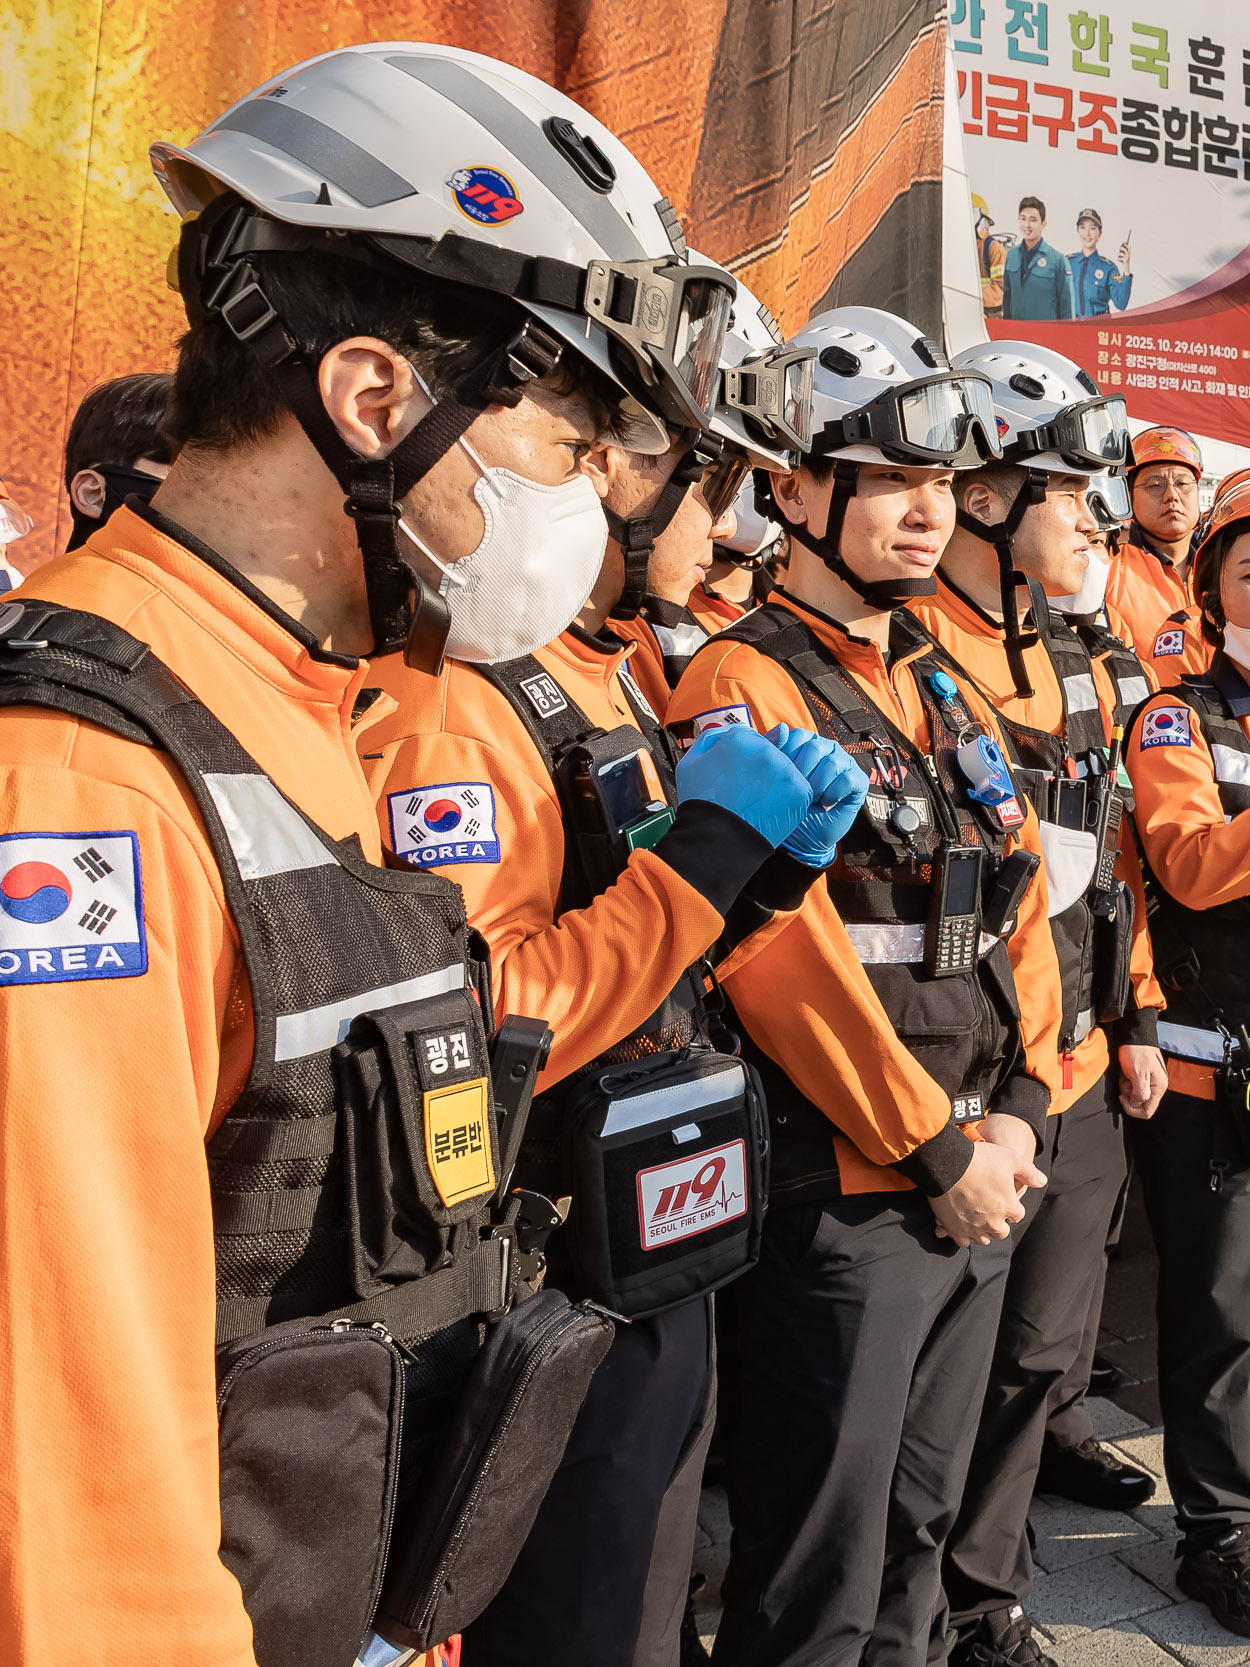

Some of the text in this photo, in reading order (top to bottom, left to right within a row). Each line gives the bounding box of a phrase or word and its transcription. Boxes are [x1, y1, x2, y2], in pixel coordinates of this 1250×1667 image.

[461, 182, 524, 221] 119
[1209, 344, 1239, 360] 14:00
[1125, 372, 1157, 389] 사업장
[527, 678, 562, 710] 광진
[1144, 735, 1187, 746] KOREA
[407, 844, 486, 864] KOREA
[0, 945, 125, 975] OREA
[425, 1032, 471, 1075] 광진
[954, 1097, 982, 1119] 광진
[434, 1120, 482, 1164] 분류반
[650, 1157, 726, 1222] 119
[650, 1209, 716, 1238] SEOUL FIRE EMS
